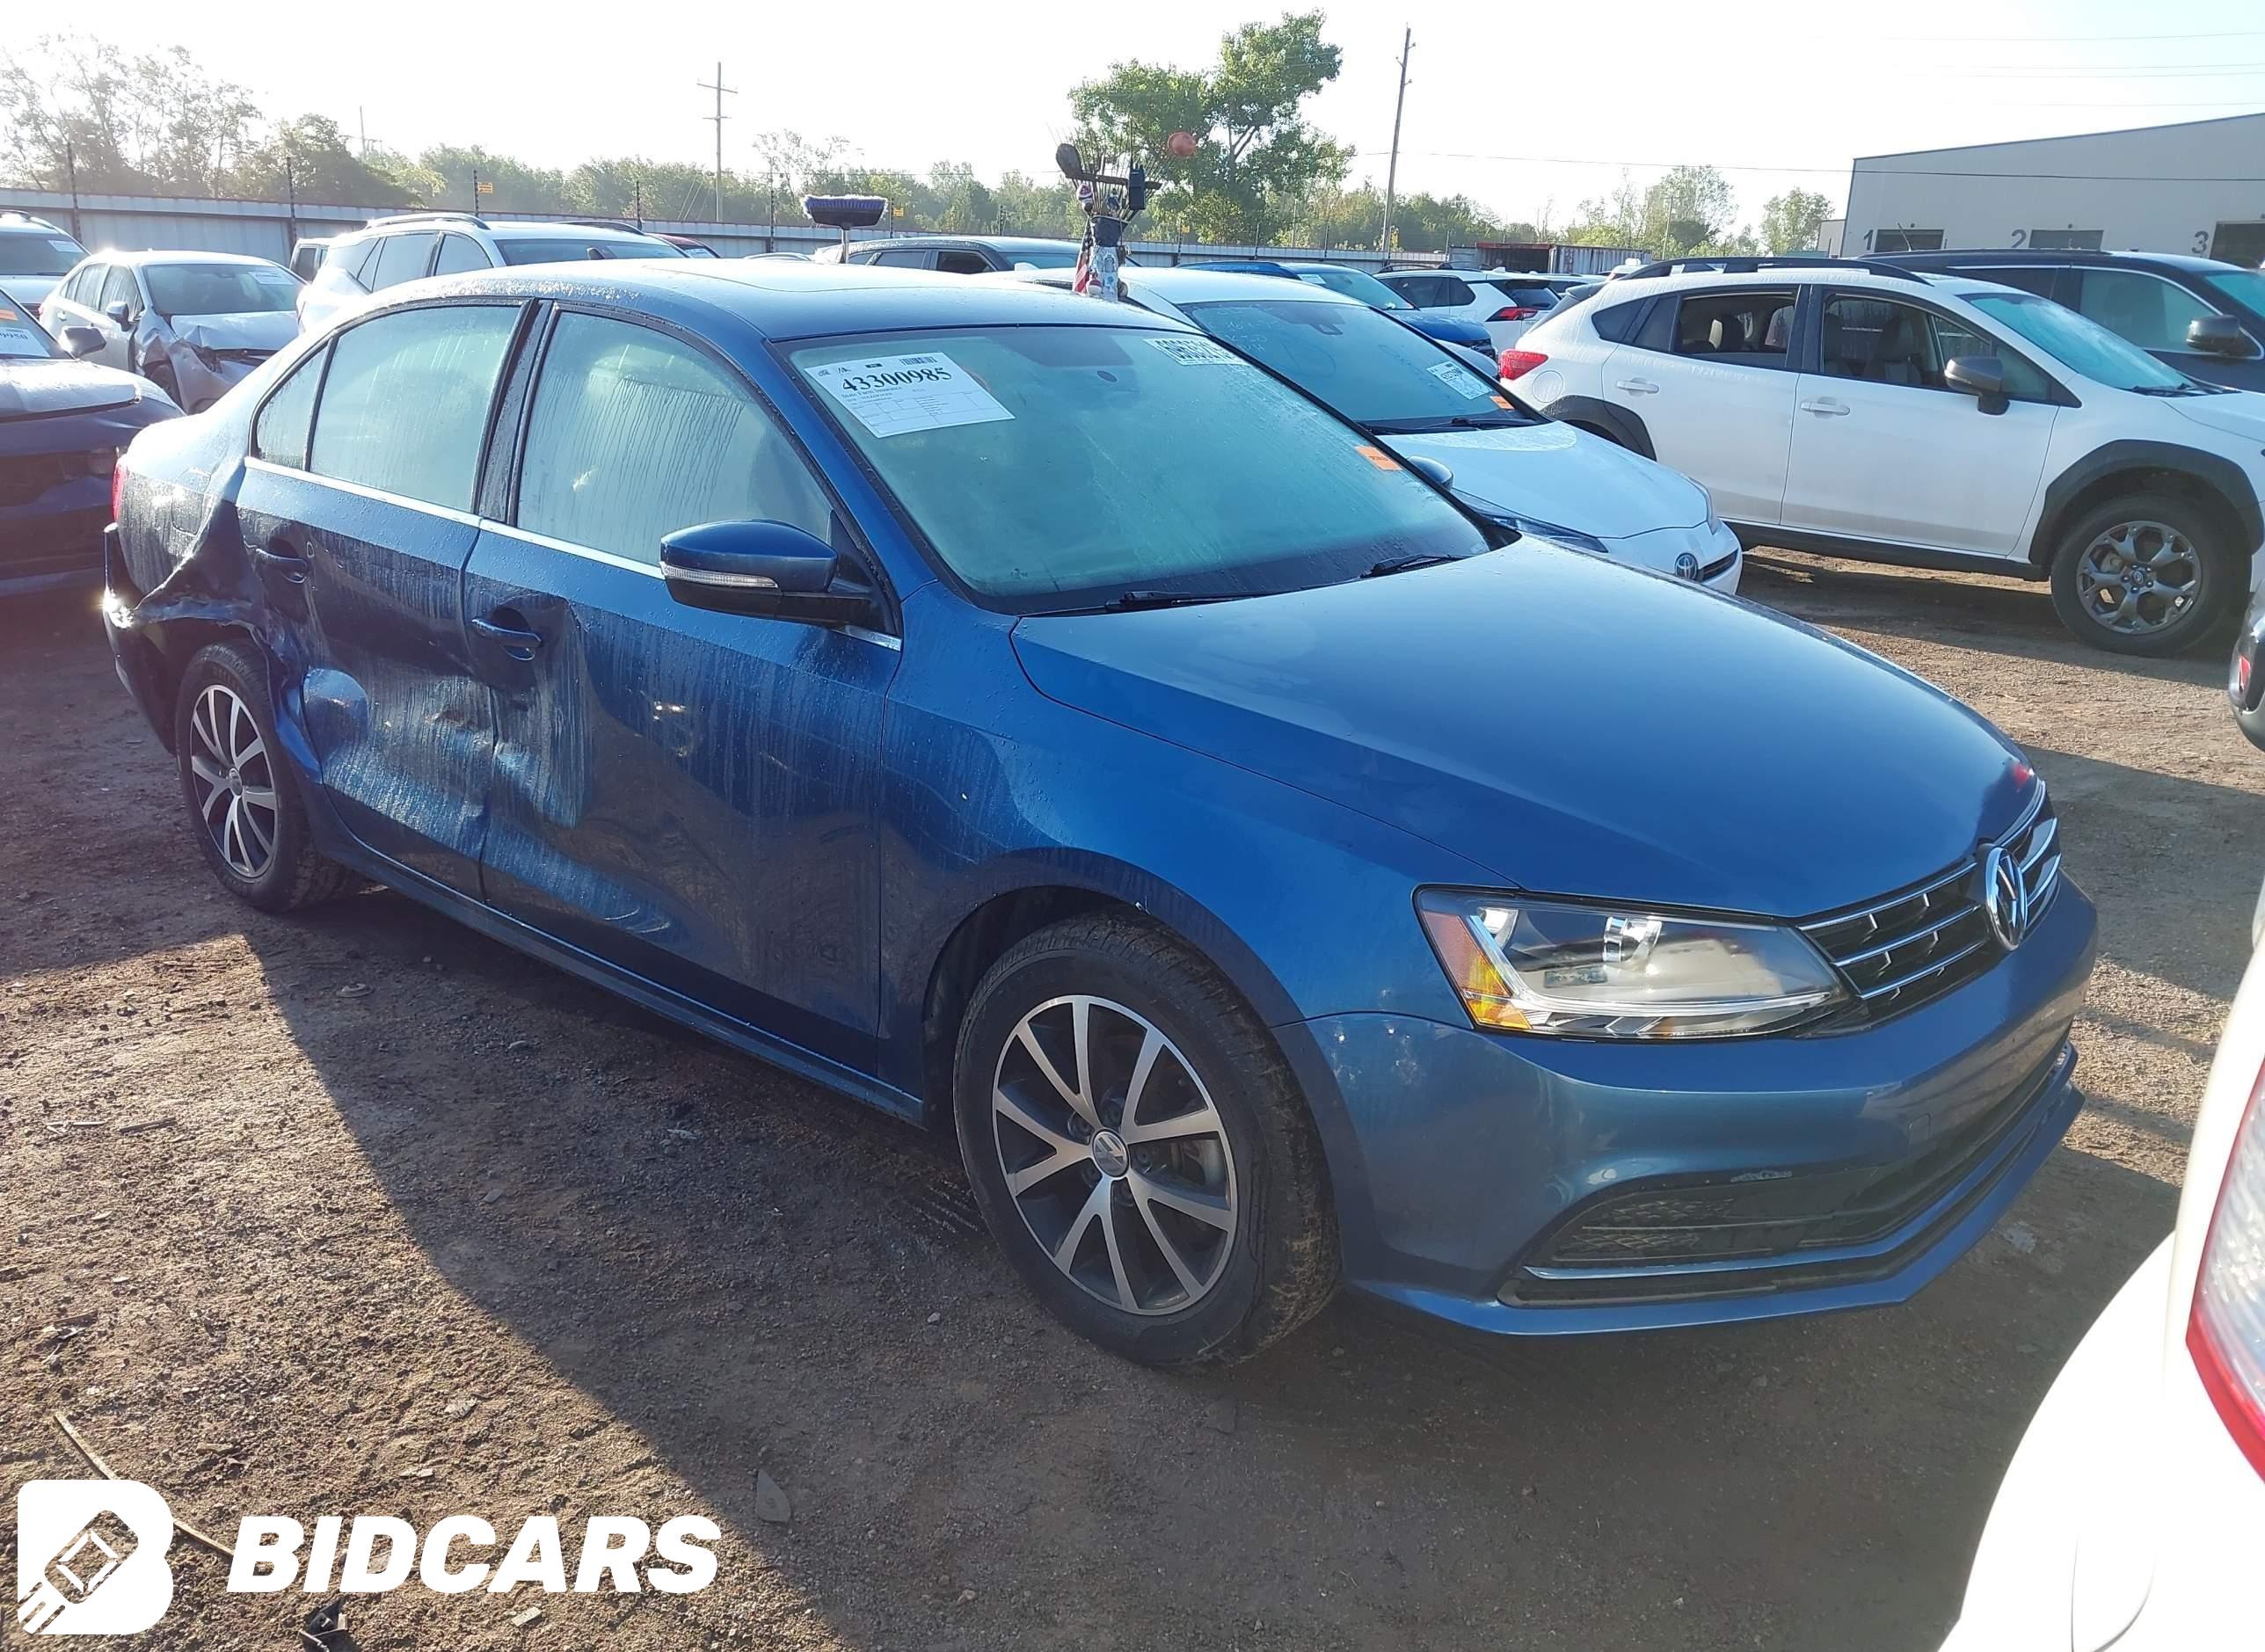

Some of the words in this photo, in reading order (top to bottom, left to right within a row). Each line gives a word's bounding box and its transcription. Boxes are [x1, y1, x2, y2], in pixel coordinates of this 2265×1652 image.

[1863, 229, 1874, 251] 1
[2011, 229, 2027, 249] 2
[2191, 230, 2209, 254] 3
[842, 368, 952, 391] 43300985
